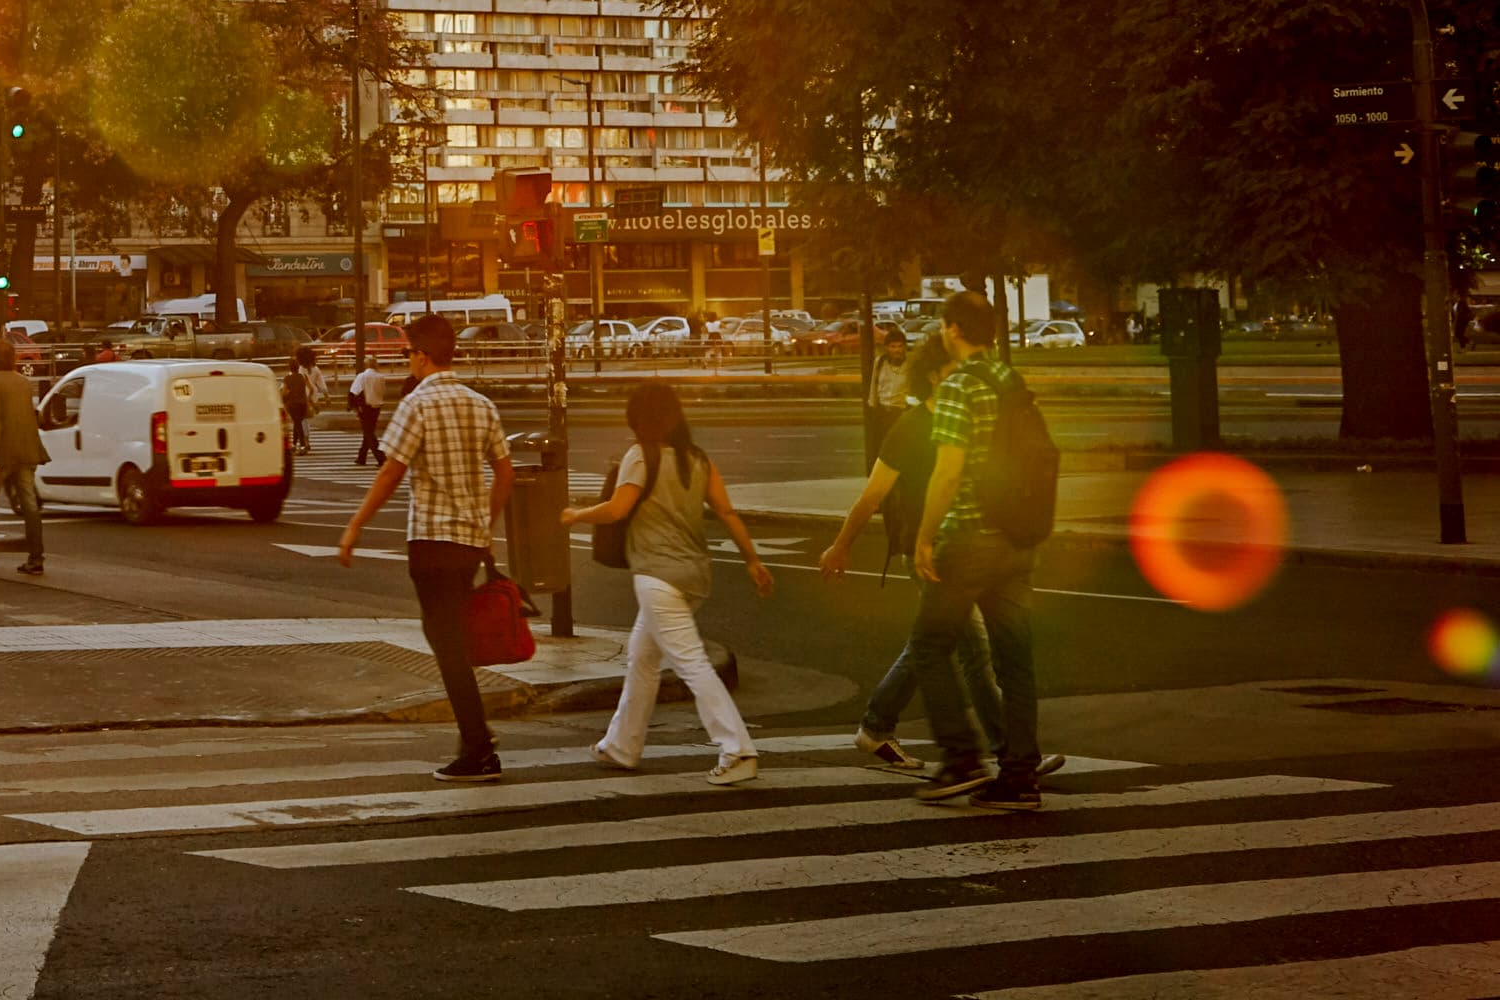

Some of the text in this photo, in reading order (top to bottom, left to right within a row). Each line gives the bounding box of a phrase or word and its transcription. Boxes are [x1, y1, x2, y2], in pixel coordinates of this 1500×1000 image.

[1333, 86, 1384, 98] Sarmiento
[1335, 113, 1357, 124] 1050
[1366, 112, 1388, 122] 1000
